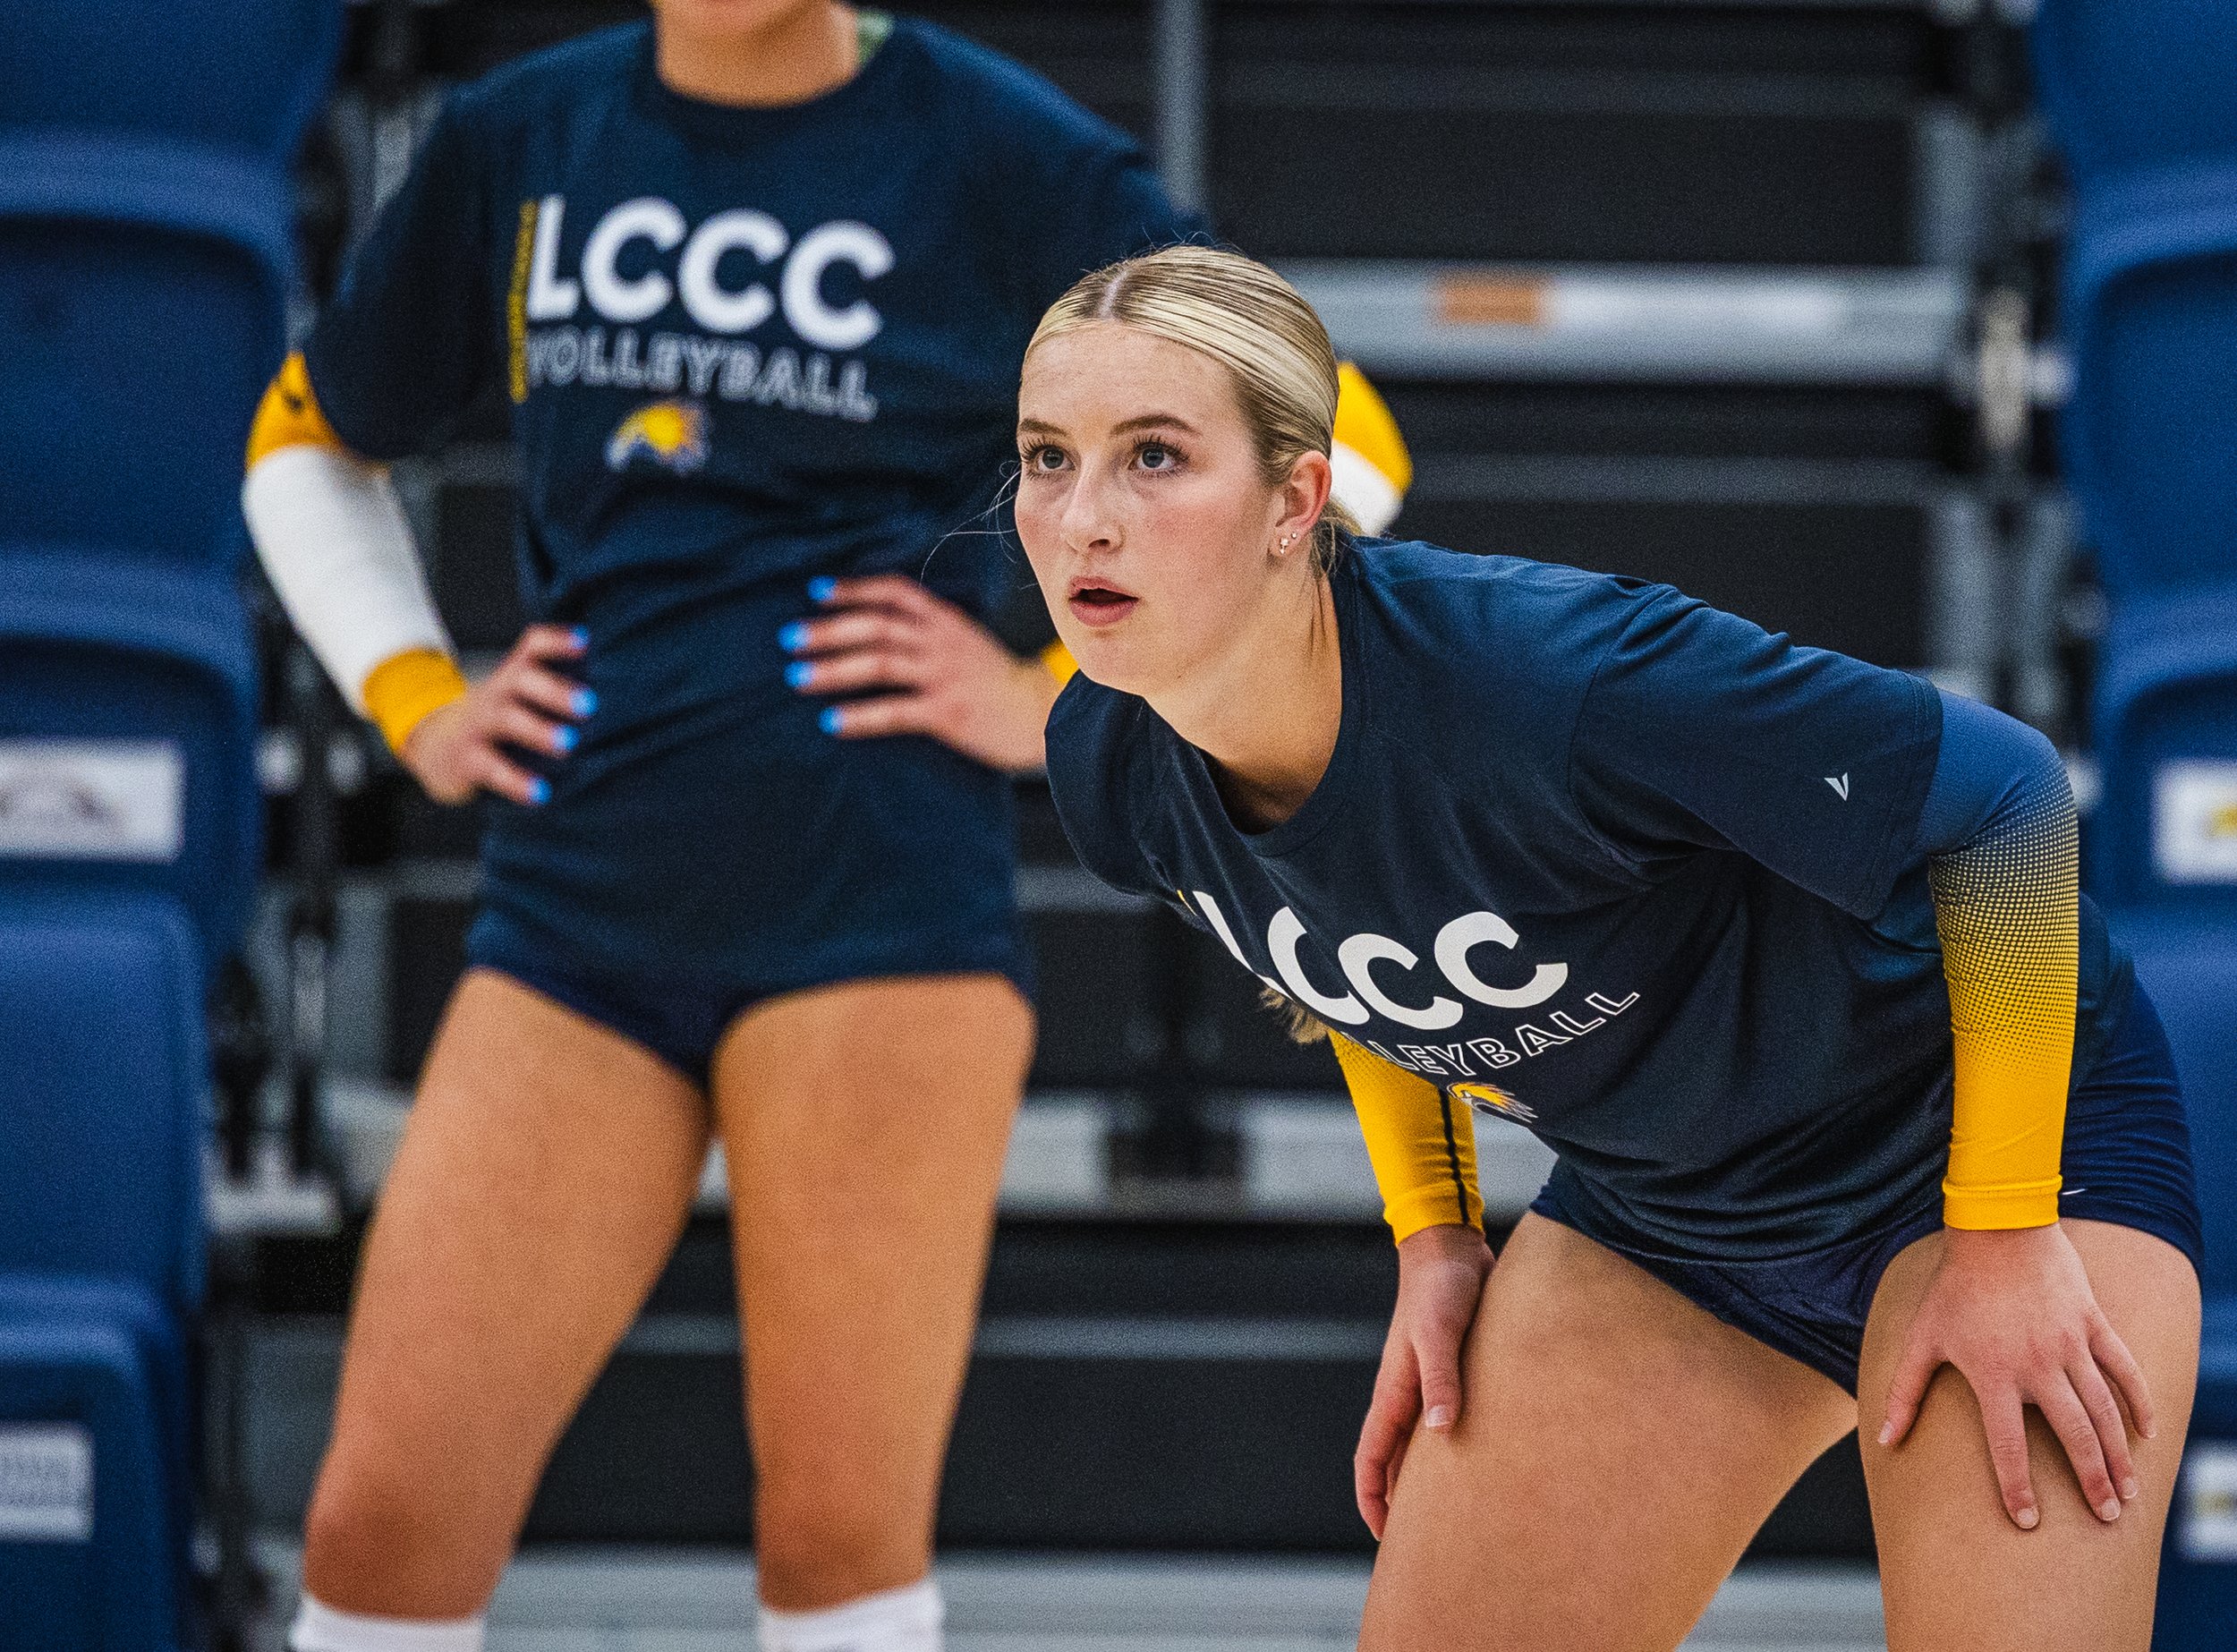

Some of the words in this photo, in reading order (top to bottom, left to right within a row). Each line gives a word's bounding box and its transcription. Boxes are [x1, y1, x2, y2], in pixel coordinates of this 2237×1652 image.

[527, 194, 894, 350] LCCC
[528, 327, 879, 422] VOLLEYBALL
[1340, 992, 1640, 1076] LEYBALL
